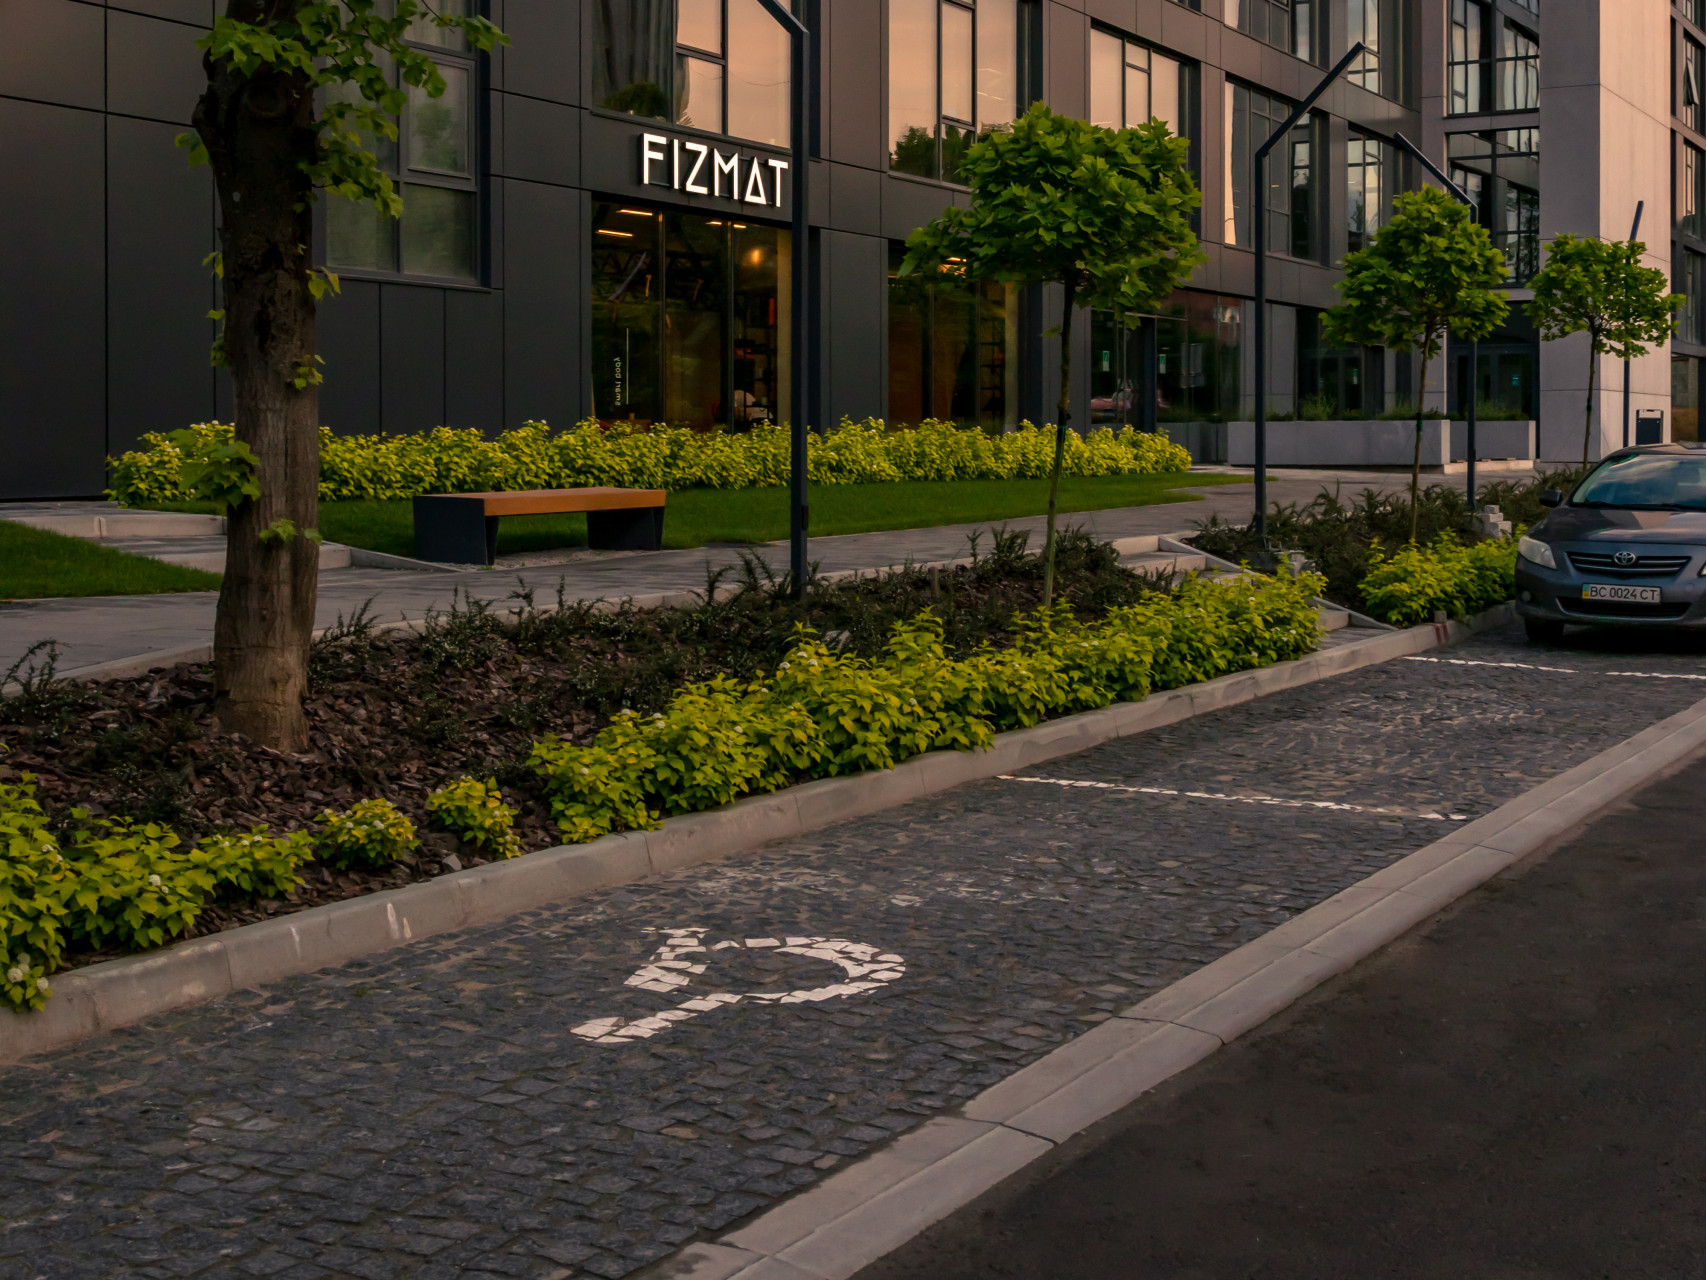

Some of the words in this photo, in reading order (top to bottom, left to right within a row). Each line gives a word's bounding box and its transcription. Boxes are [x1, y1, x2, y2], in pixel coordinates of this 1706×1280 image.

[642, 133, 789, 208] FIZMAT
[1590, 586, 1607, 597] BC
[1609, 587, 1637, 599] 0024
[1640, 589, 1658, 600] CT
